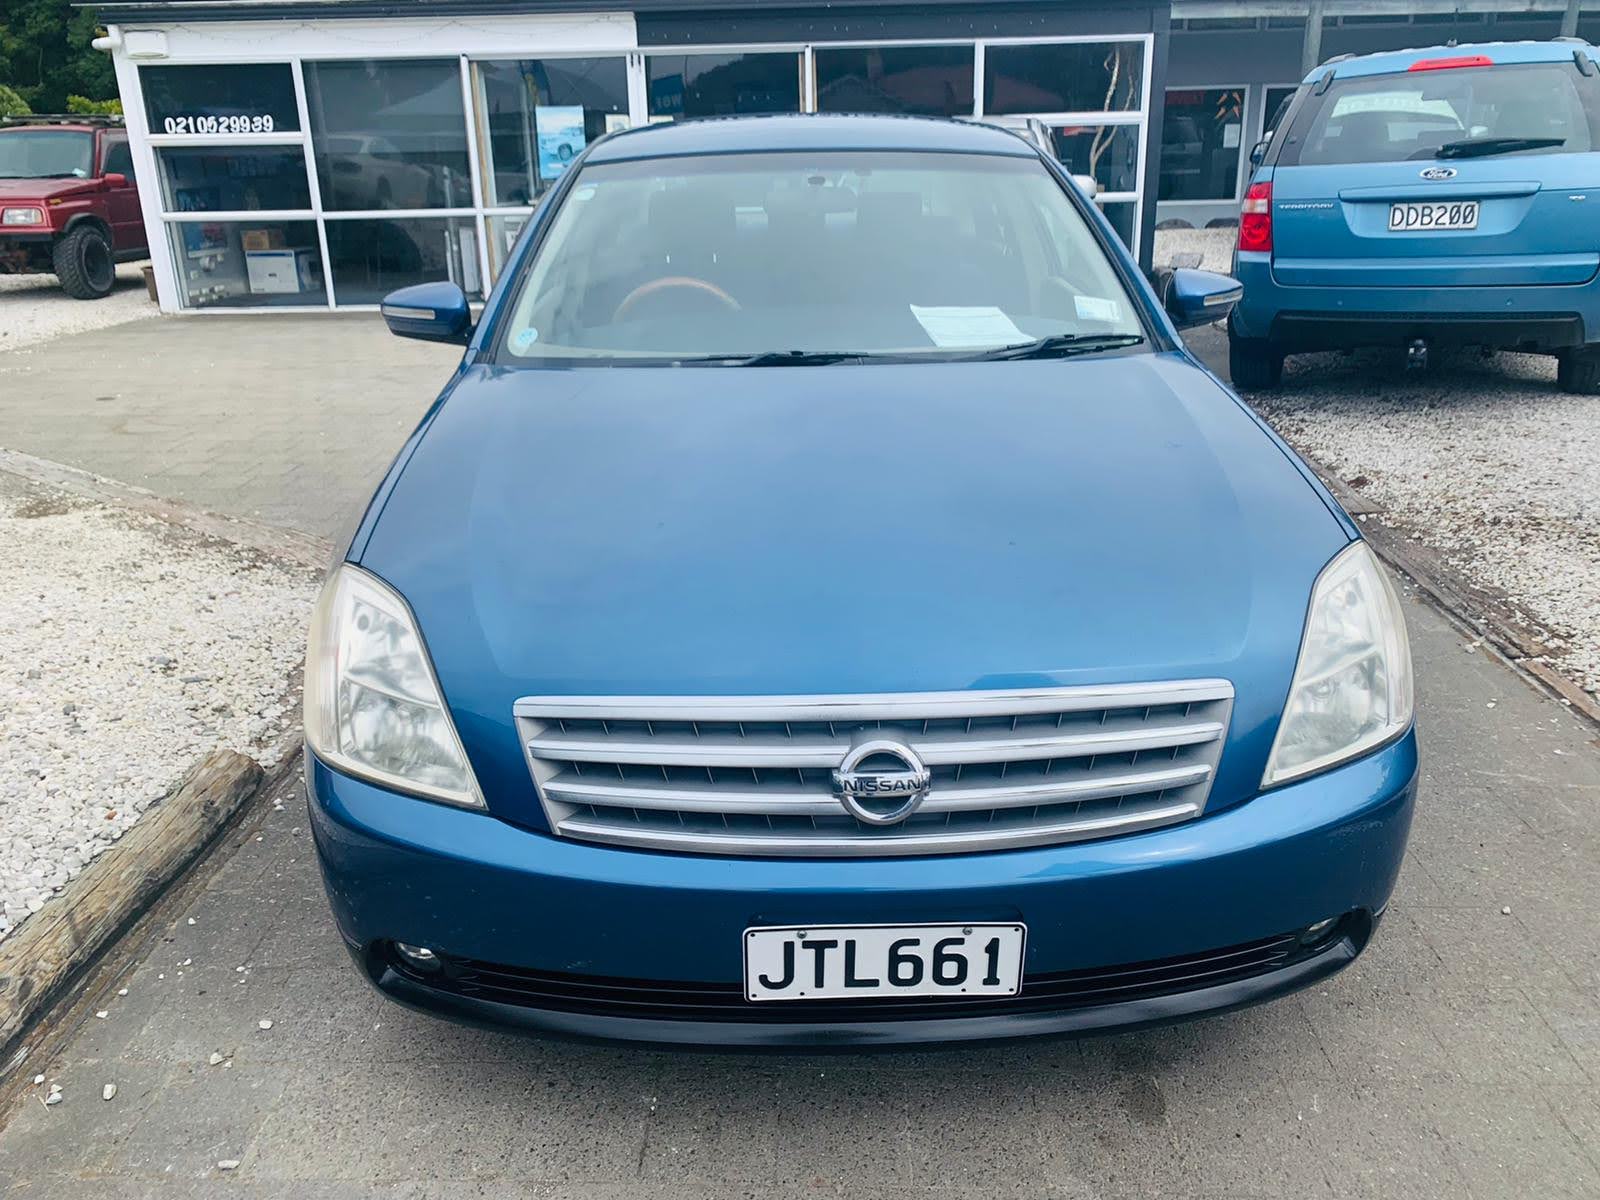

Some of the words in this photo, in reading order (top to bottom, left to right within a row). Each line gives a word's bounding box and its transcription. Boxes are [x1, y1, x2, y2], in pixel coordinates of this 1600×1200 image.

[1391, 205, 1475, 227] DDB200
[843, 779, 921, 792] NISSAN
[758, 937, 1000, 990] JTL661
